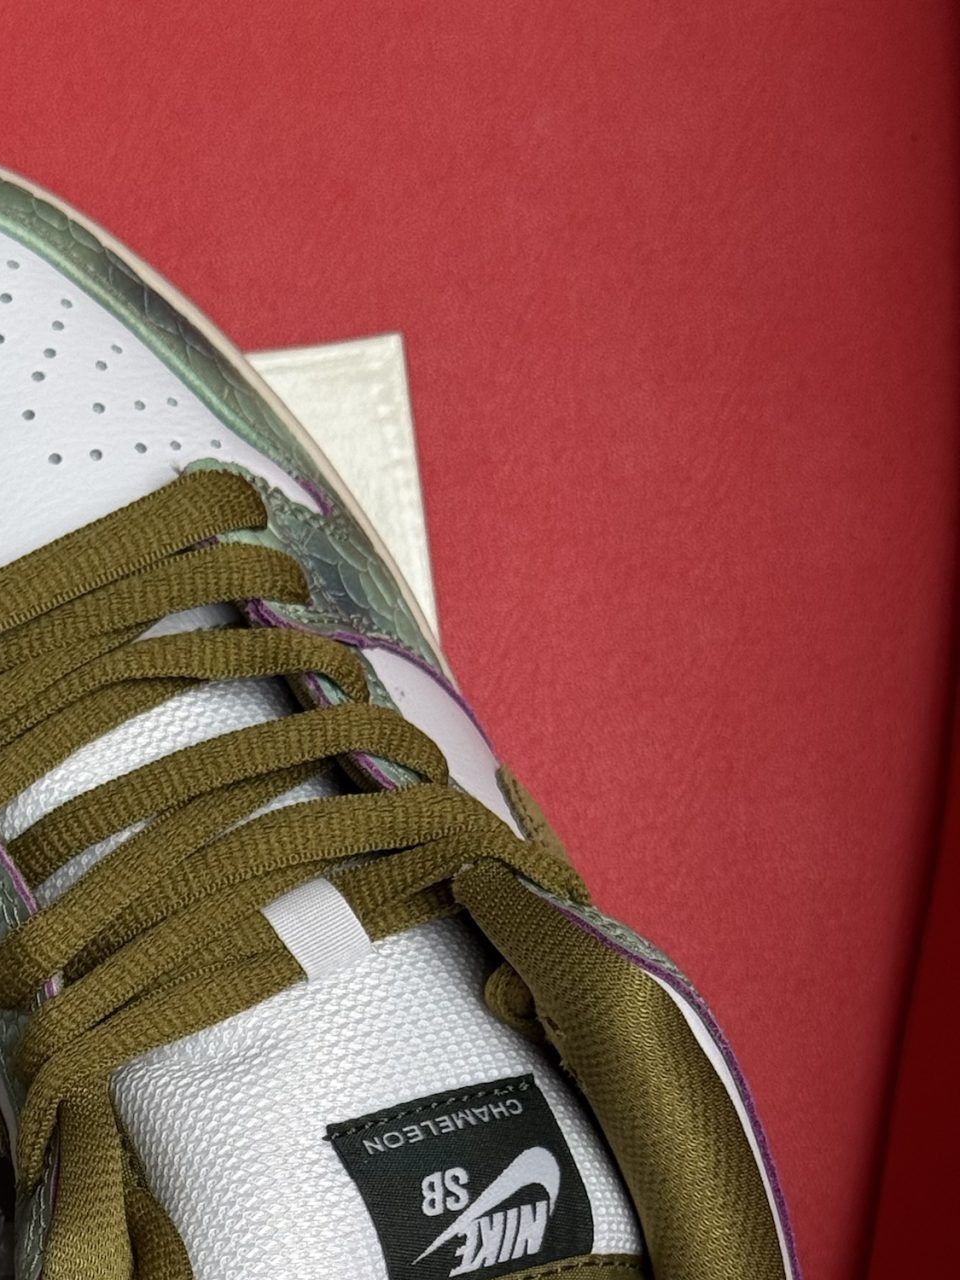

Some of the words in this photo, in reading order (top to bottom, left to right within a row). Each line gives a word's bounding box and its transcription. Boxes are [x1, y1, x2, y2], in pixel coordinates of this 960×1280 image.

[362, 1099, 523, 1155] CHAMELEON
[421, 1167, 470, 1217] SB
[448, 1200, 548, 1278] NIKE
